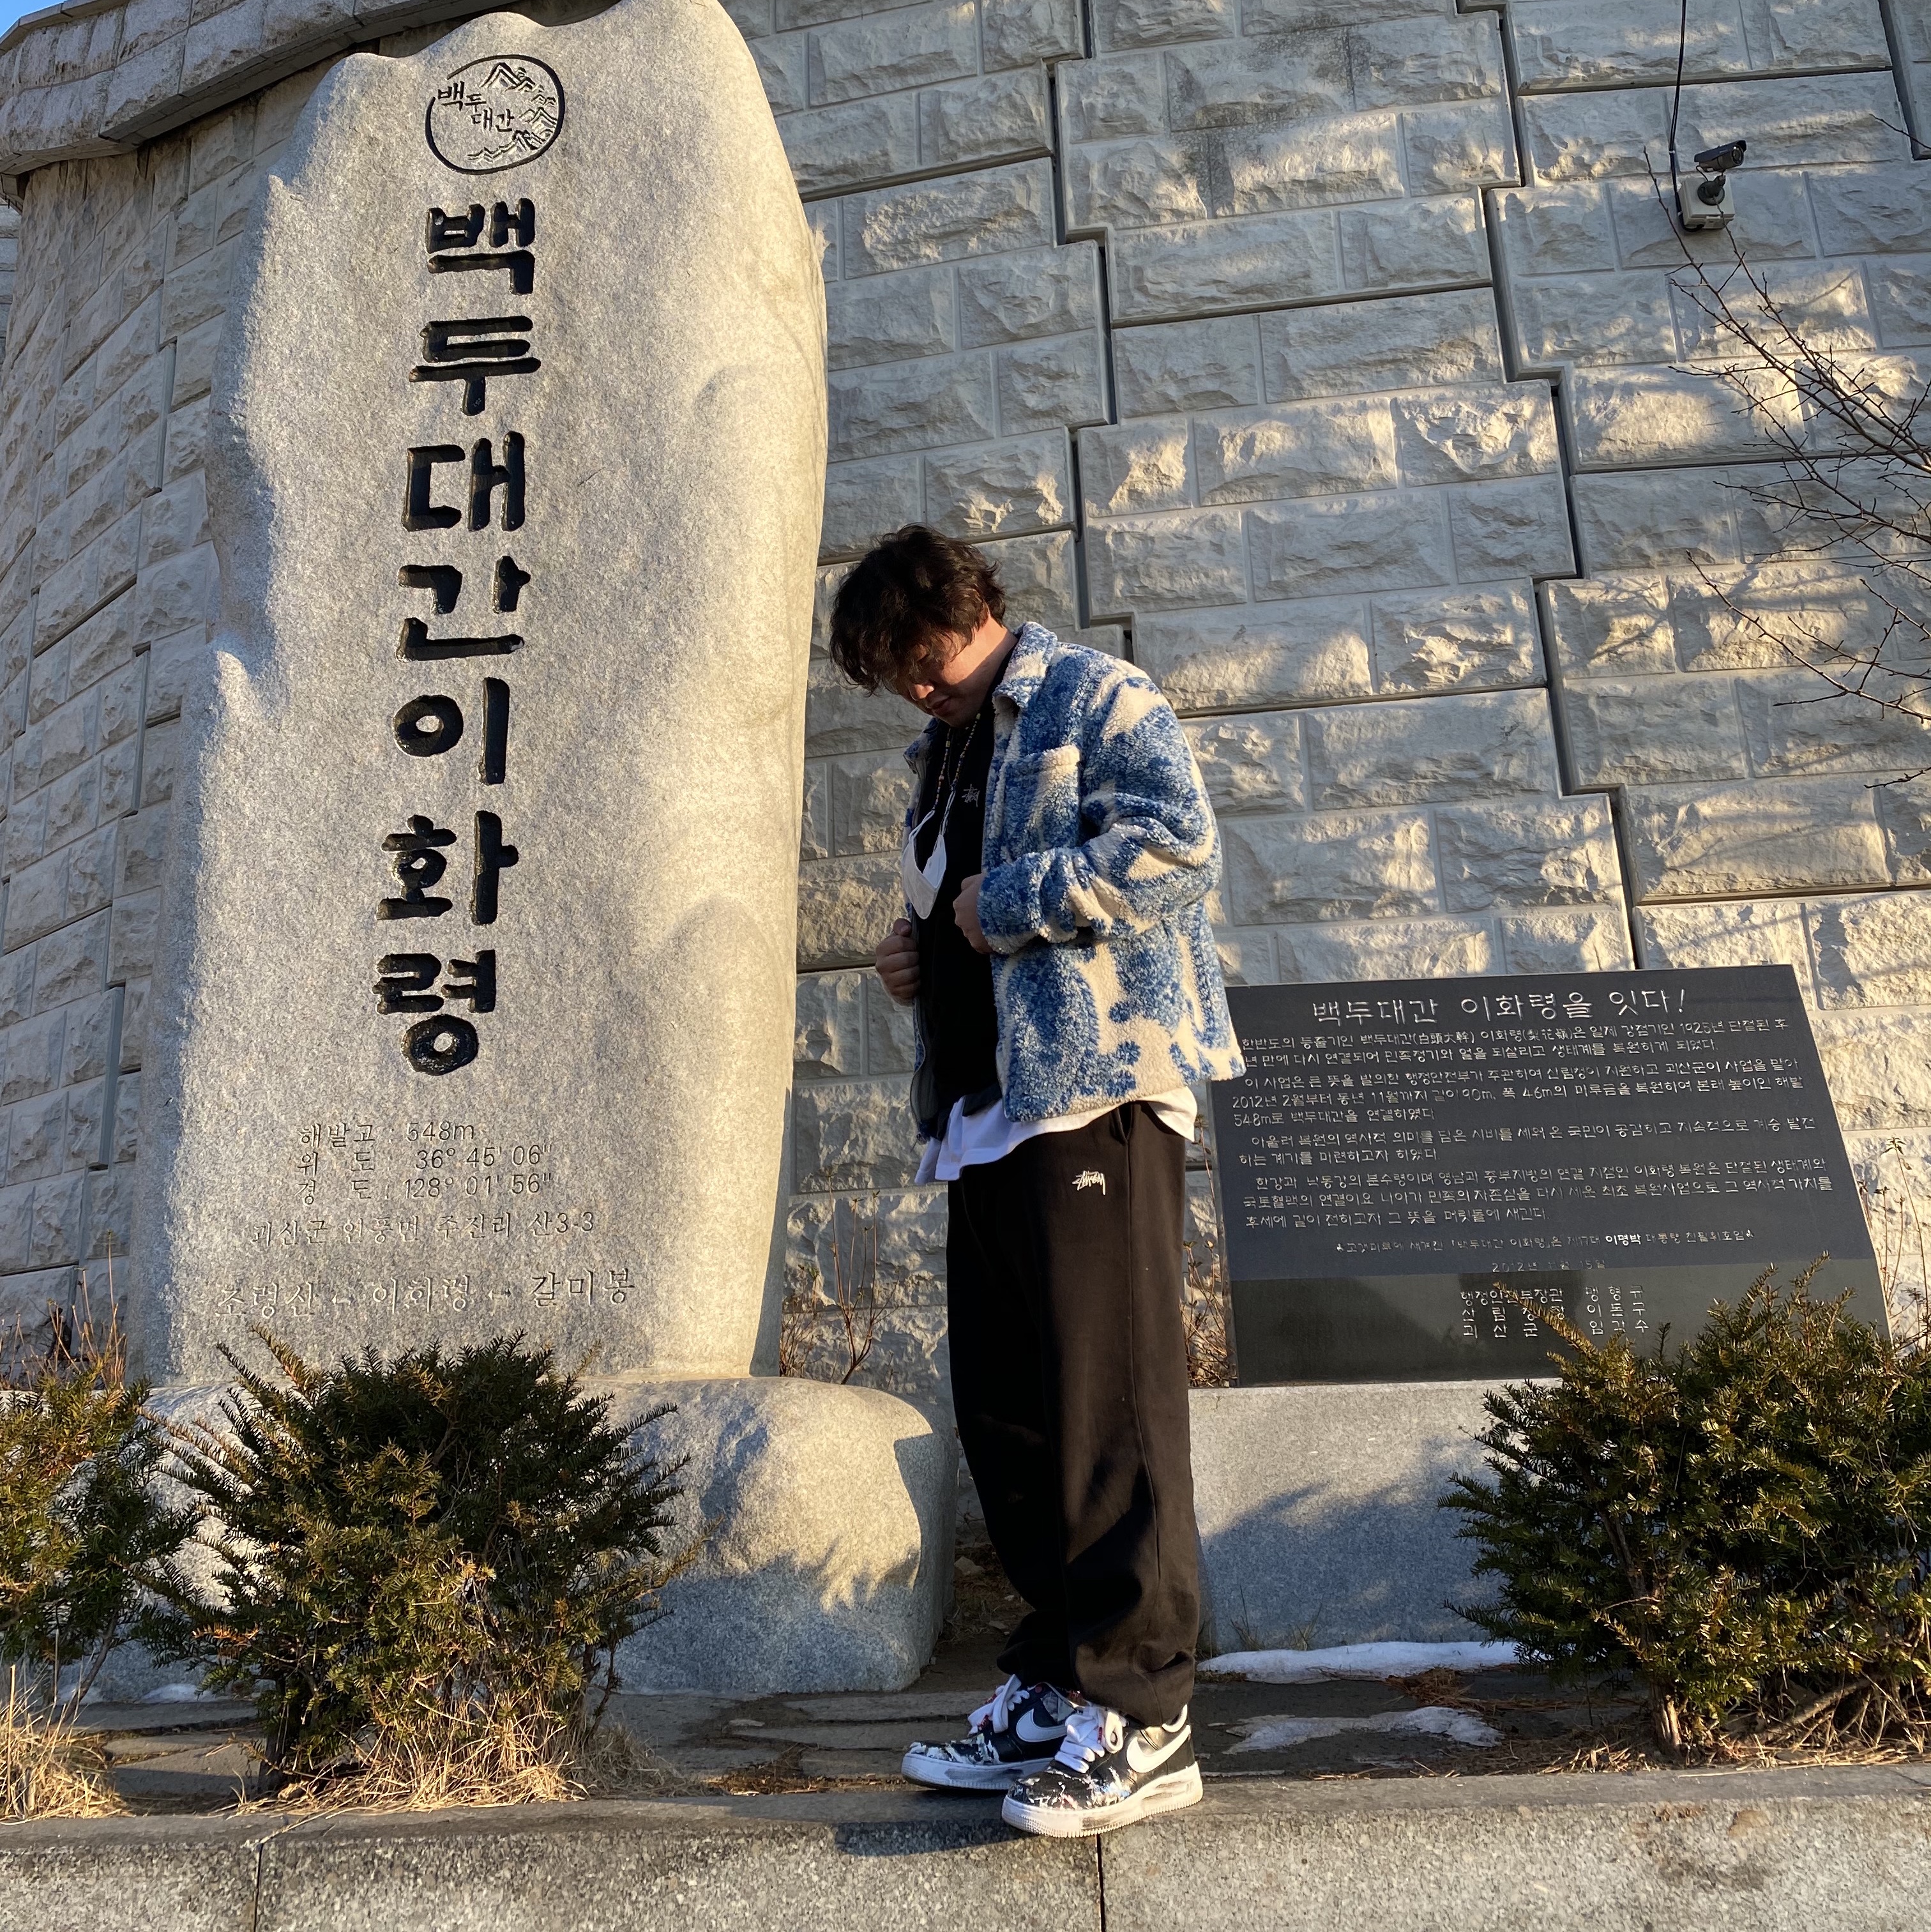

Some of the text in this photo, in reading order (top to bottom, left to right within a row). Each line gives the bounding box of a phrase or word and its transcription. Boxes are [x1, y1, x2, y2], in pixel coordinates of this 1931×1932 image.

[437, 80, 487, 112] 백두
[471, 107, 514, 132] 대간
[1312, 989, 1685, 1026] 백두대간 이화령을 잇다!
[1242, 1037, 1295, 1050] 한반도의
[1300, 1035, 1353, 1049] 등줄기인
[1589, 1026, 1617, 1038] 일제
[1621, 1023, 1674, 1037] 강점기인
[1680, 1020, 1725, 1035] 1925년
[1729, 1019, 1770, 1032] 단절된
[1775, 1018, 1789, 1030] 후
[1262, 1054, 1289, 1067] 만에
[1294, 1054, 1320, 1065] 다시
[1325, 1051, 1379, 1065] 연결되어
[1385, 1049, 1453, 1063] 민족정기와
[1459, 1047, 1487, 1060] 얼을
[1492, 1045, 1545, 1060] 되살리고
[1552, 1042, 1606, 1058] 생태계를
[1613, 1040, 1669, 1054] 복원하게
[1676, 1039, 1718, 1051] 되었다.
[1245, 1078, 1258, 1090] 이
[1264, 1076, 1305, 1090] 사업은
[1309, 1076, 1322, 1088] 큰
[1328, 1074, 1354, 1088] 뜻을
[1360, 1073, 1399, 1086] 발의한
[1405, 1070, 1483, 1086] 행정안전부가
[1487, 1069, 1543, 1082] 주관하여
[1547, 1066, 1600, 1080] 산림청이
[1605, 1063, 1660, 1077] 지원하고
[1665, 1061, 1721, 1074] 괴산군이
[1725, 1058, 1767, 1073] 사업을
[1232, 1095, 1277, 1108] 2012년
[1282, 1093, 1332, 1107] 2월부터
[1337, 1092, 1365, 1106] 동년
[1372, 1090, 1428, 1104] 11월까지
[1503, 1087, 1516, 1099] 폭
[1522, 1084, 1567, 1099] 46m의
[1575, 1083, 1631, 1097] 마루금을
[1635, 1080, 1692, 1094] 복원하여
[1697, 1079, 1725, 1092] 본래
[1729, 1077, 1771, 1091] 높이인
[1775, 1076, 1804, 1089] 해발
[1234, 1113, 1285, 1127] 548m로
[1291, 1109, 1358, 1123] 백두대간을
[1251, 1135, 1294, 1149] 아울러
[1298, 1133, 1340, 1146] 복원의
[1345, 1132, 1386, 1145] 역사적
[1393, 1130, 1434, 1144] 의미를
[1438, 1129, 1467, 1143] 담은
[1473, 1128, 1513, 1141] 시비를
[1568, 1124, 1610, 1138] 국민이
[1615, 1122, 1672, 1137] 공감하고
[1677, 1119, 1750, 1134] 지속적으로
[1753, 1118, 1781, 1132] 계승
[1787, 1117, 1816, 1130] 발전
[299, 1122, 376, 1148] 해발고
[406, 1121, 474, 1141] 548m
[1239, 1154, 1267, 1168] 하는
[1271, 1151, 1313, 1165] 계기를
[1319, 1149, 1389, 1164] 마련하고자
[1256, 1158, 1827, 1190] 한강과 낙동강의 분수령이며 영남과 중부지방의 연결 지점인 이화령 복원은 단절된 생태계와
[1243, 1176, 1833, 1208] 국토혈맥의 연결이요 나아가 민족의 자존심을 다시 세운 최초 복원사업으로 그 역사적 가치를
[250, 1210, 594, 1246] 괴산군 연풍면 주진리 산3-3
[1245, 1215, 1287, 1229] 후세에
[1292, 1214, 1321, 1228] 길이
[1326, 1213, 1382, 1226] 전하고자
[1388, 1213, 1402, 1224] 그
[1407, 1210, 1436, 1224] 뜻을
[1444, 1208, 1501, 1223] 머릿돌에
[1605, 1233, 1642, 1247] 이명박
[1646, 1232, 1681, 1245] 대통령
[528, 1268, 635, 1308] 갈미봉
